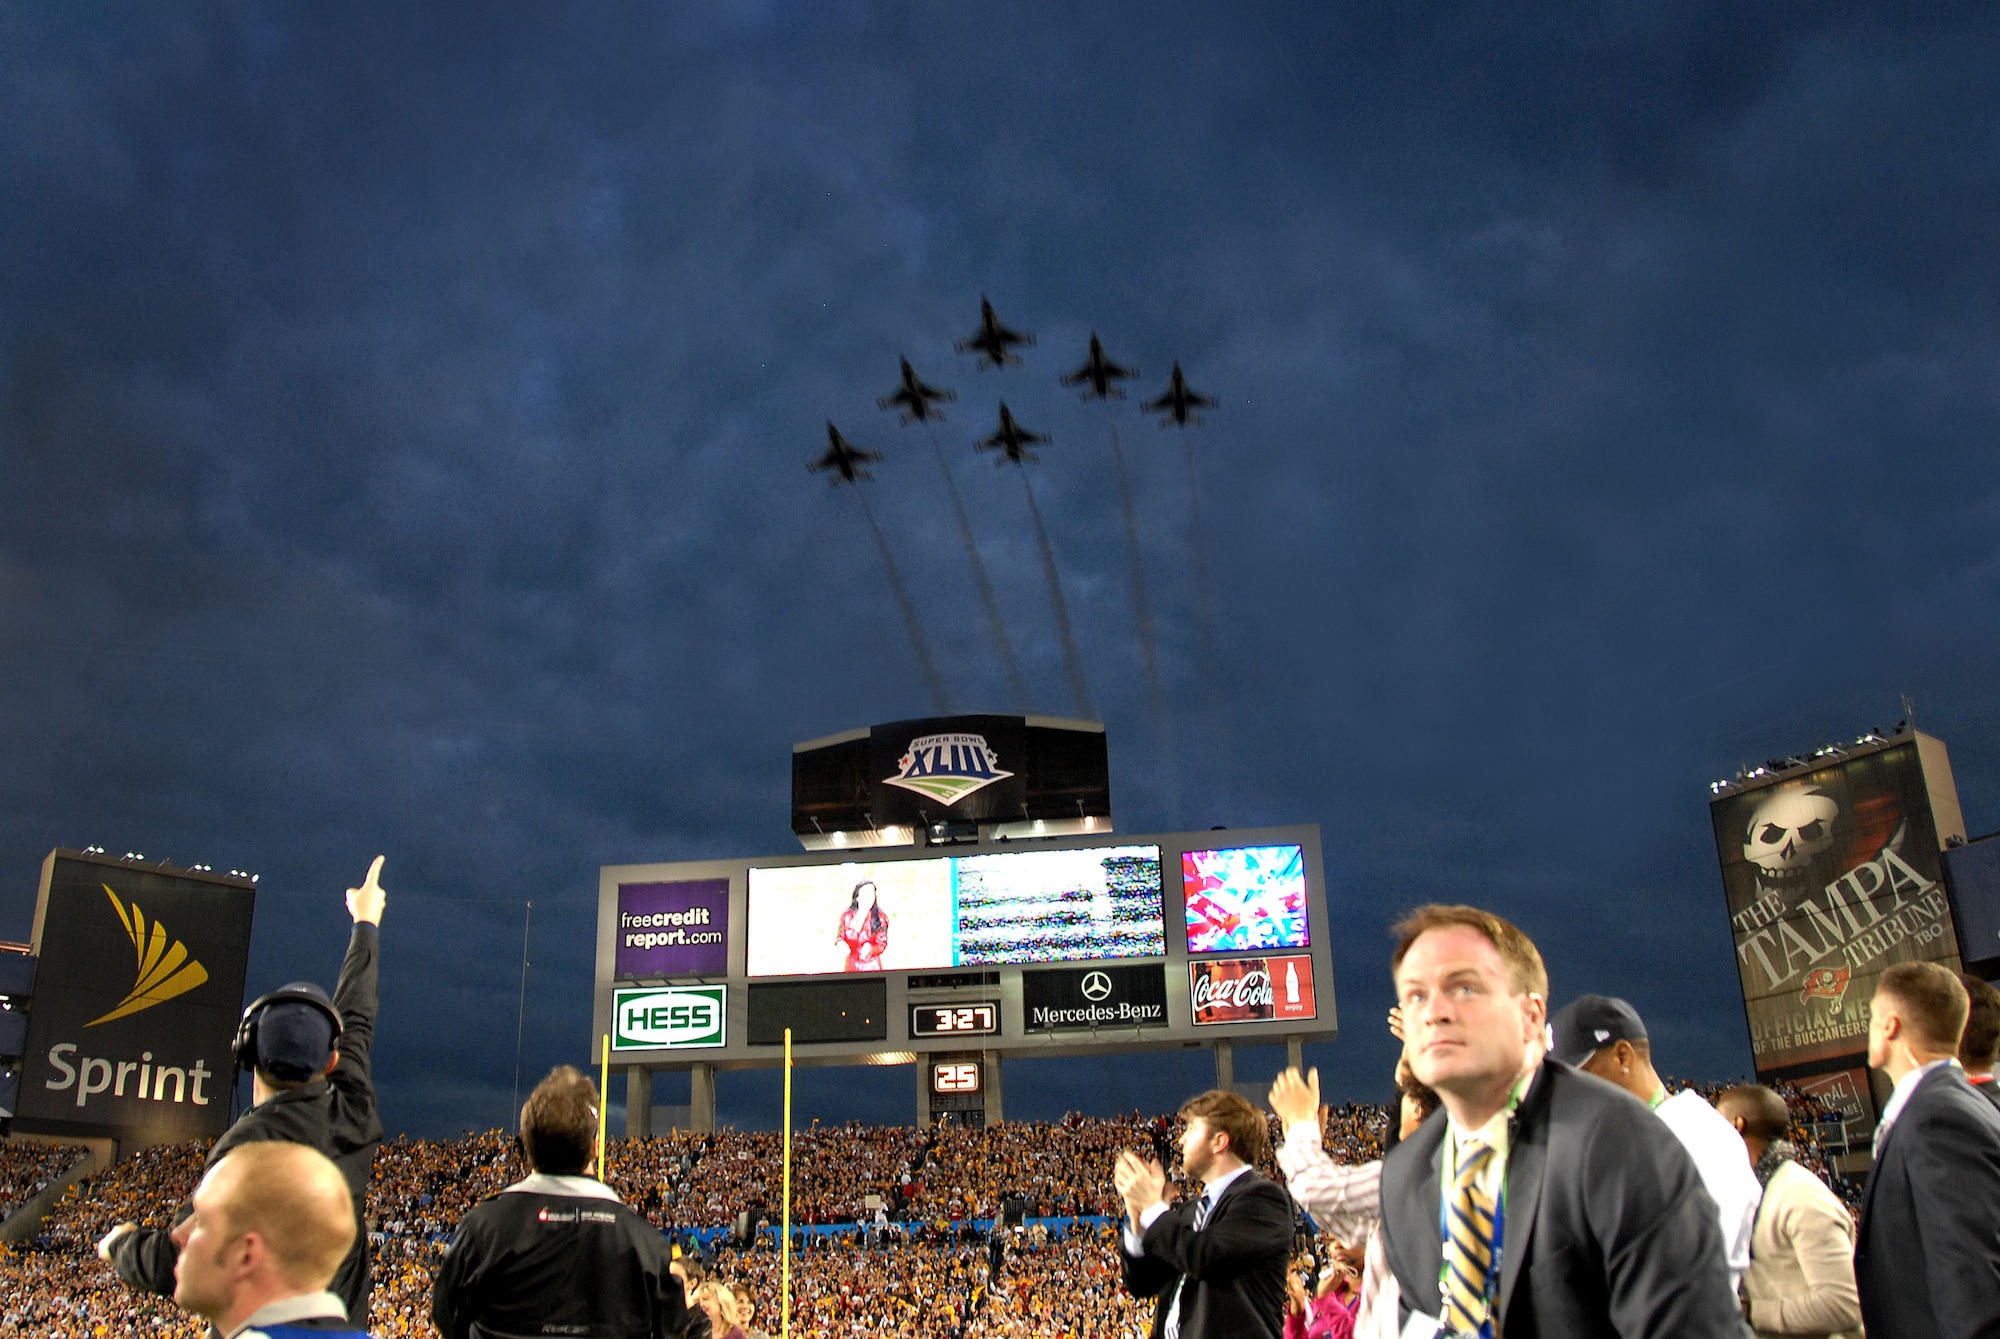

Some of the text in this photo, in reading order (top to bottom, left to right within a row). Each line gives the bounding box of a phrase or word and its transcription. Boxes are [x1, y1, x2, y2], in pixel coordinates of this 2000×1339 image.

[912, 734, 985, 749] SUPER BOWL
[903, 744, 1003, 780] XLIII
[621, 907, 710, 928] freecredit
[1733, 889, 1787, 936] THE
[1738, 847, 1937, 990] TAMPA
[625, 928, 722, 950] report.com
[1842, 888, 1950, 969] TRIBUNE
[1194, 970, 1275, 1012] Coca-Cola
[627, 1005, 712, 1031] HESS
[935, 1008, 992, 1032] 3:27
[1033, 1003, 1162, 1025] Mercedes-Benz
[1284, 1003, 1304, 1012] enjoy
[1752, 1007, 1837, 1041] OFFICIAL
[1753, 1019, 1869, 1055] OF THE BUCCANEERS
[45, 1043, 212, 1107] Sprint
[937, 1065, 977, 1090] 25
